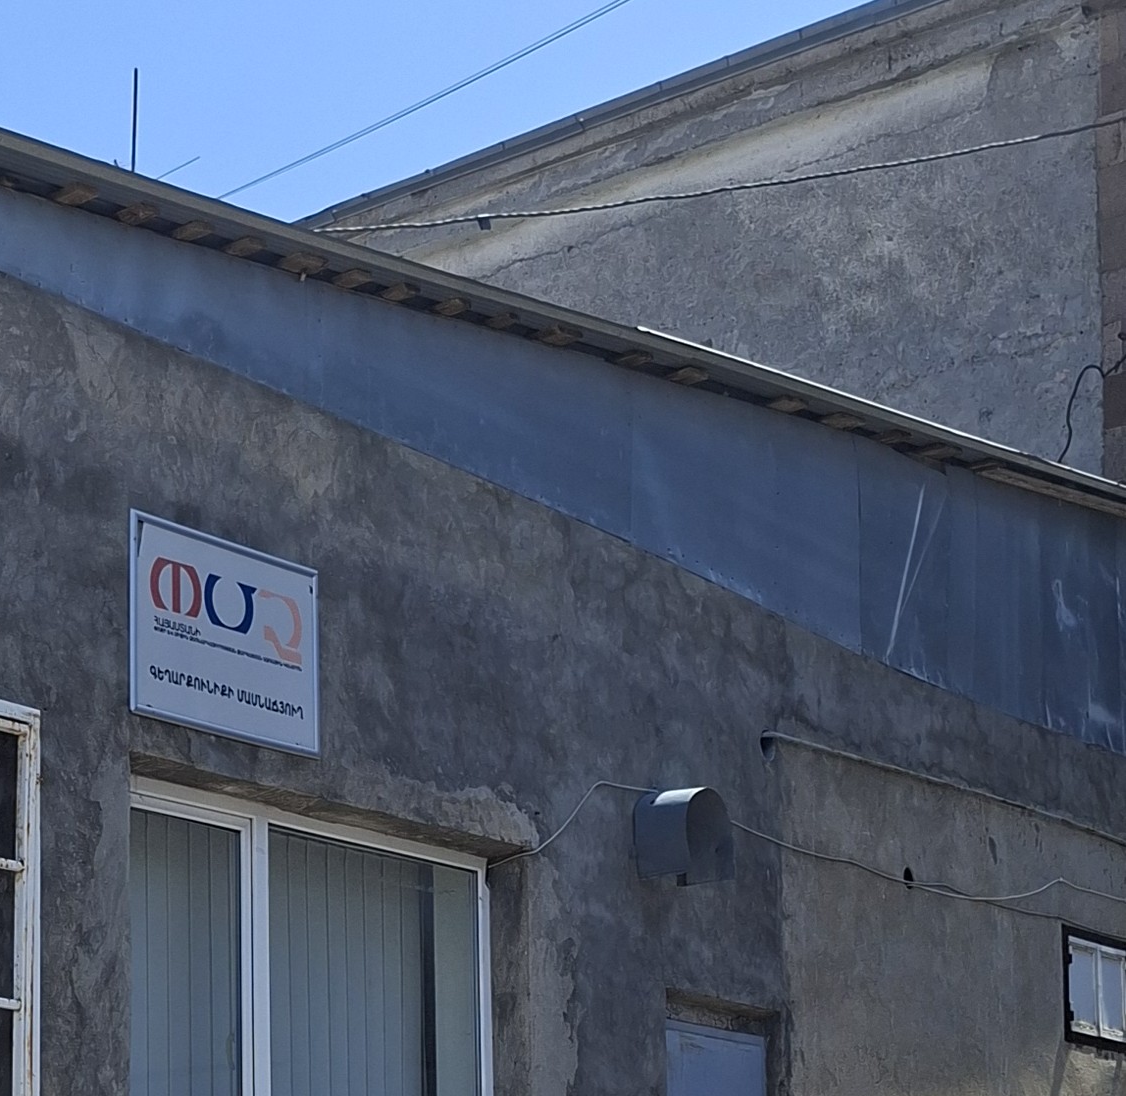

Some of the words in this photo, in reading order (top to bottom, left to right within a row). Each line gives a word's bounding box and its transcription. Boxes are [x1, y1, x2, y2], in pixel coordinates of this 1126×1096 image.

[153, 615, 202, 637] ՀԱՅԱՍՏԱՆԻ
[149, 665, 234, 699] ԳԵՂԱՐՔՈՒՆԻՔԻ
[237, 688, 304, 720] ՄԱՍՆԱՃՅՈՒՂ
